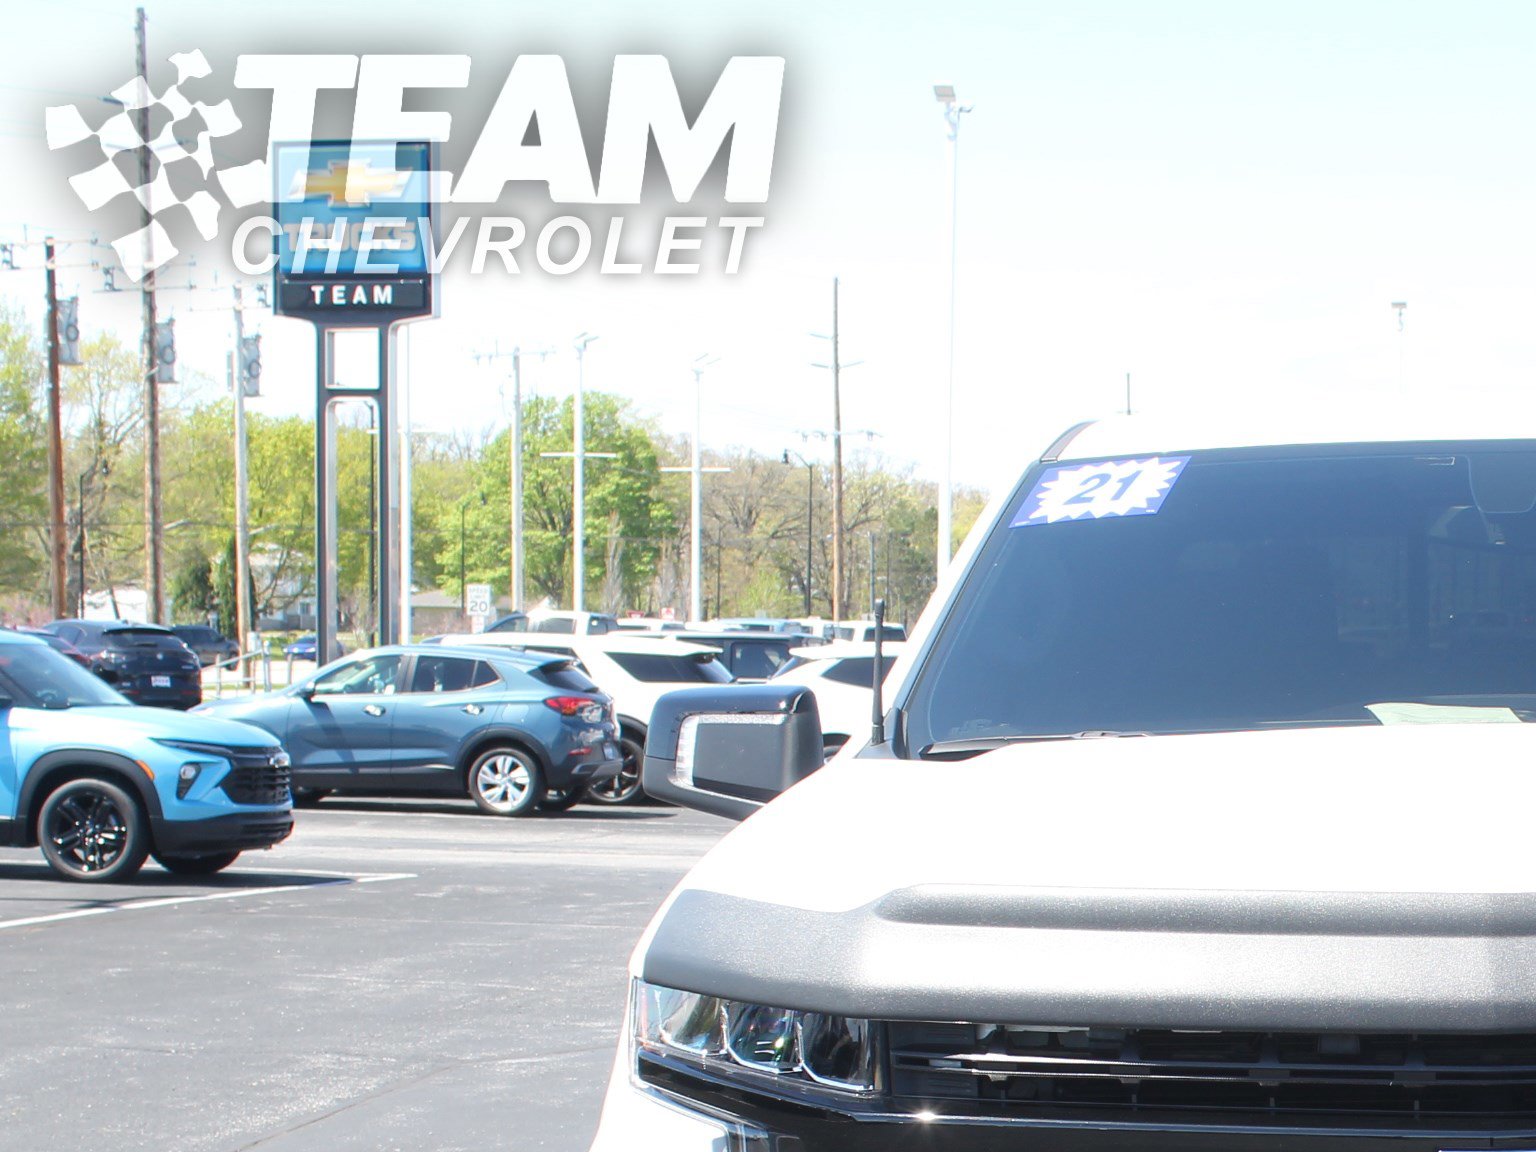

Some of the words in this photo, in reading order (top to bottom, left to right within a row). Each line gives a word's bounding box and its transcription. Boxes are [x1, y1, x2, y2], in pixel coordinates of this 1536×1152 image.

[310, 284, 393, 306] TEAM
[1062, 470, 1143, 505] 21
[469, 600, 488, 612] 20
